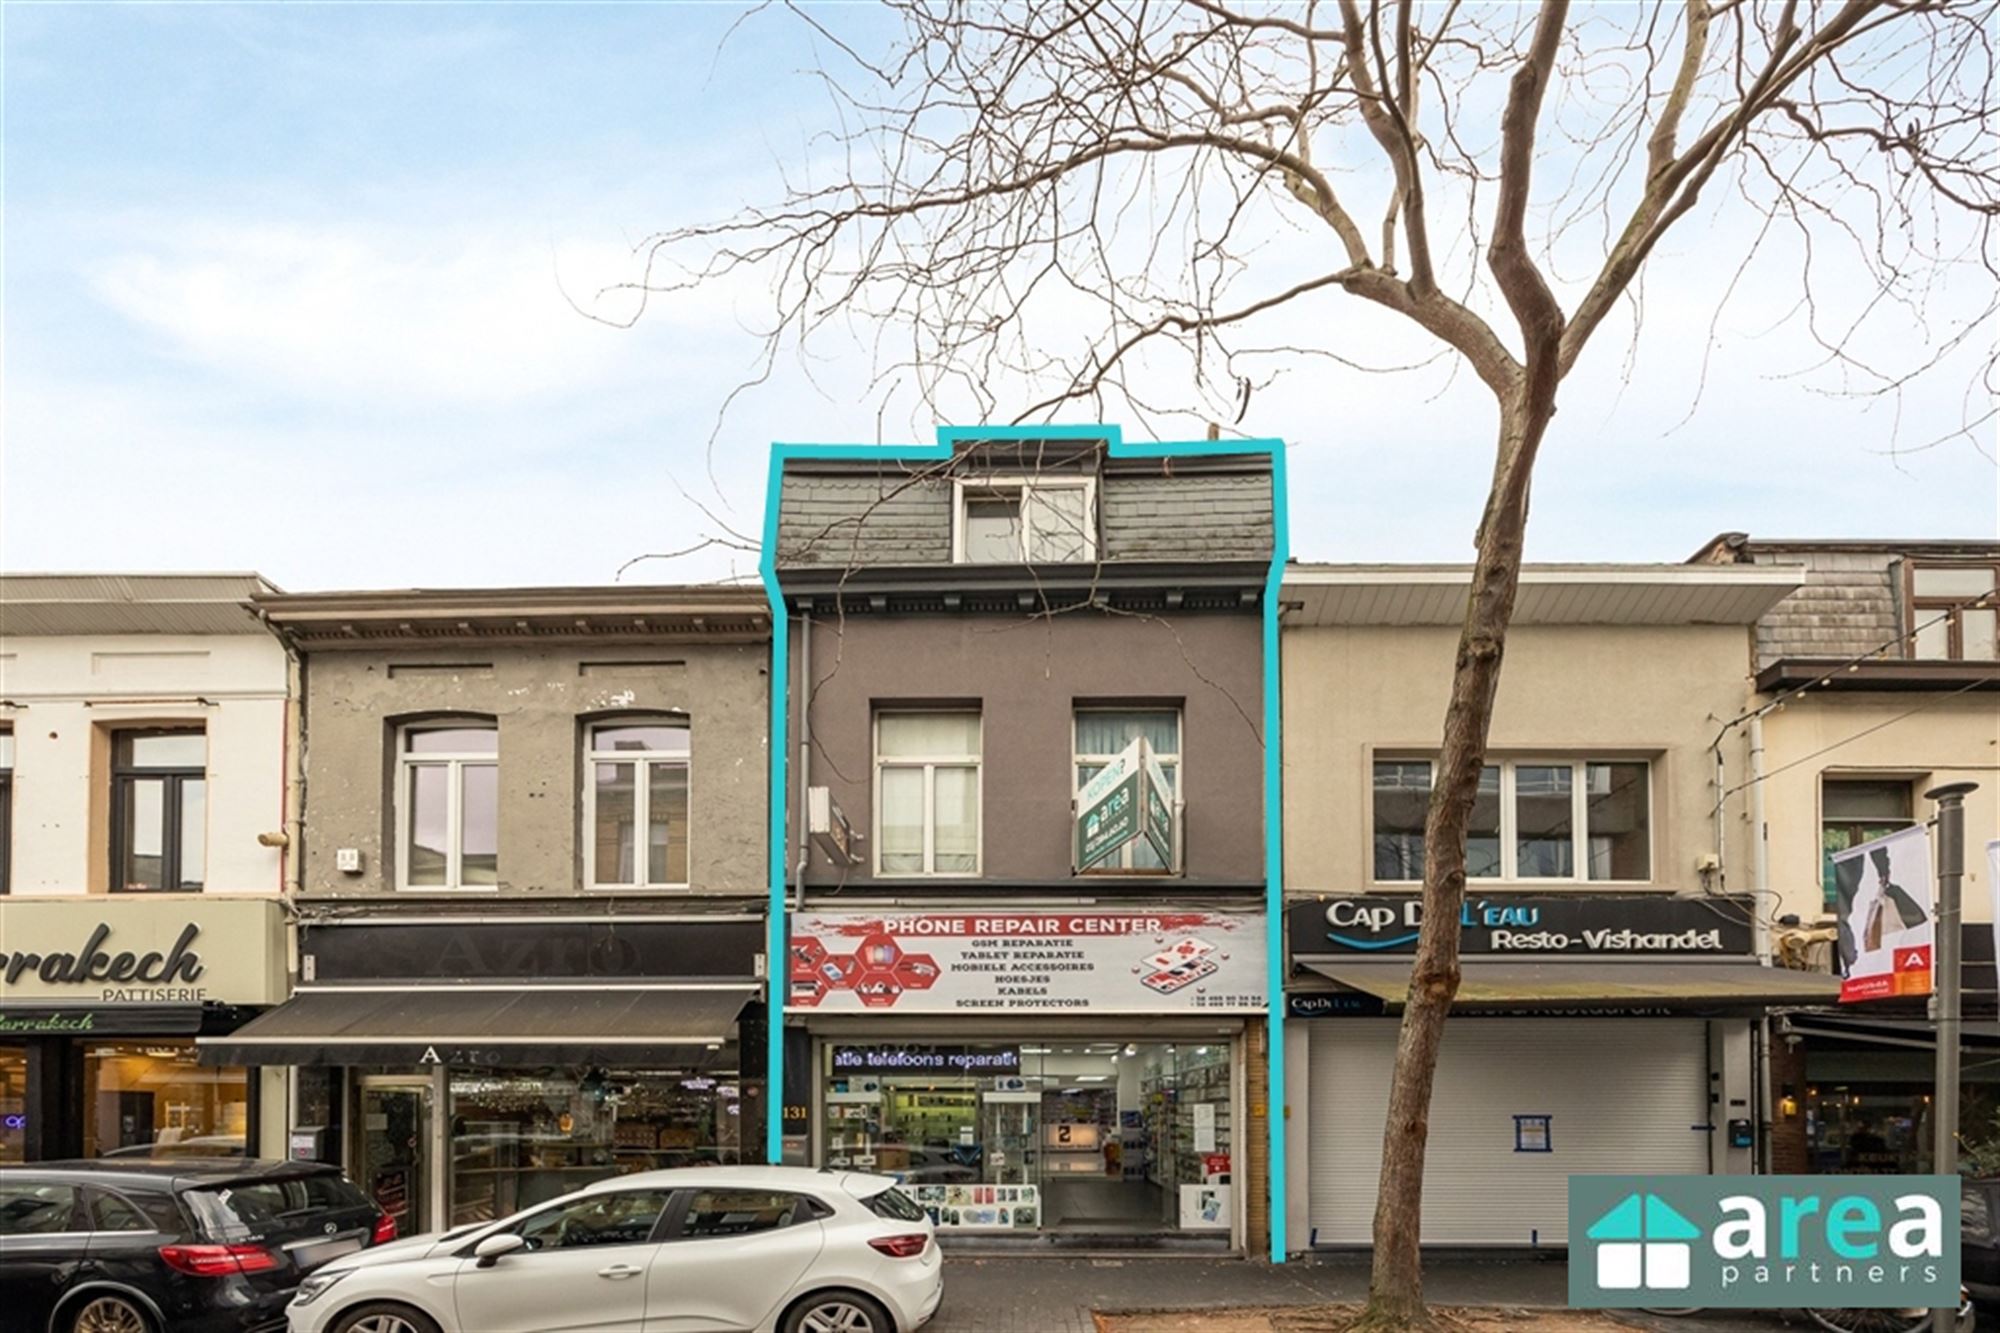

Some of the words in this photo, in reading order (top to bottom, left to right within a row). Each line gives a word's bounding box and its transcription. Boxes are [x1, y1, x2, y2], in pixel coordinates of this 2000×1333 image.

[1101, 788, 1129, 822] area
[1405, 902, 1422, 927] D
[884, 918, 965, 934] PHONE
[975, 918, 1060, 934] REPAIR
[1069, 918, 1161, 934] CENTER
[972, 939, 998, 948] GSM
[1002, 939, 1074, 948] REPARATIE
[1491, 928, 1723, 950] Resto-Vishandel
[0, 922, 204, 984] rakech
[961, 951, 1009, 960] TABLET
[1013, 951, 1085, 960] REPARATIE
[1904, 952, 1924, 967] A
[951, 963, 1007, 972] MOBIELE
[1011, 963, 1095, 972] ACCESSOIRES
[995, 975, 1051, 984] HOESJES
[103, 988, 207, 1001] PATTISERIE
[998, 987, 1047, 996] KABELS
[956, 999, 1004, 1008] SCREEN
[1009, 999, 1089, 1008] PROTECTORS
[0, 1012, 94, 1030] arrakech
[783, 1106, 807, 1120] 131
